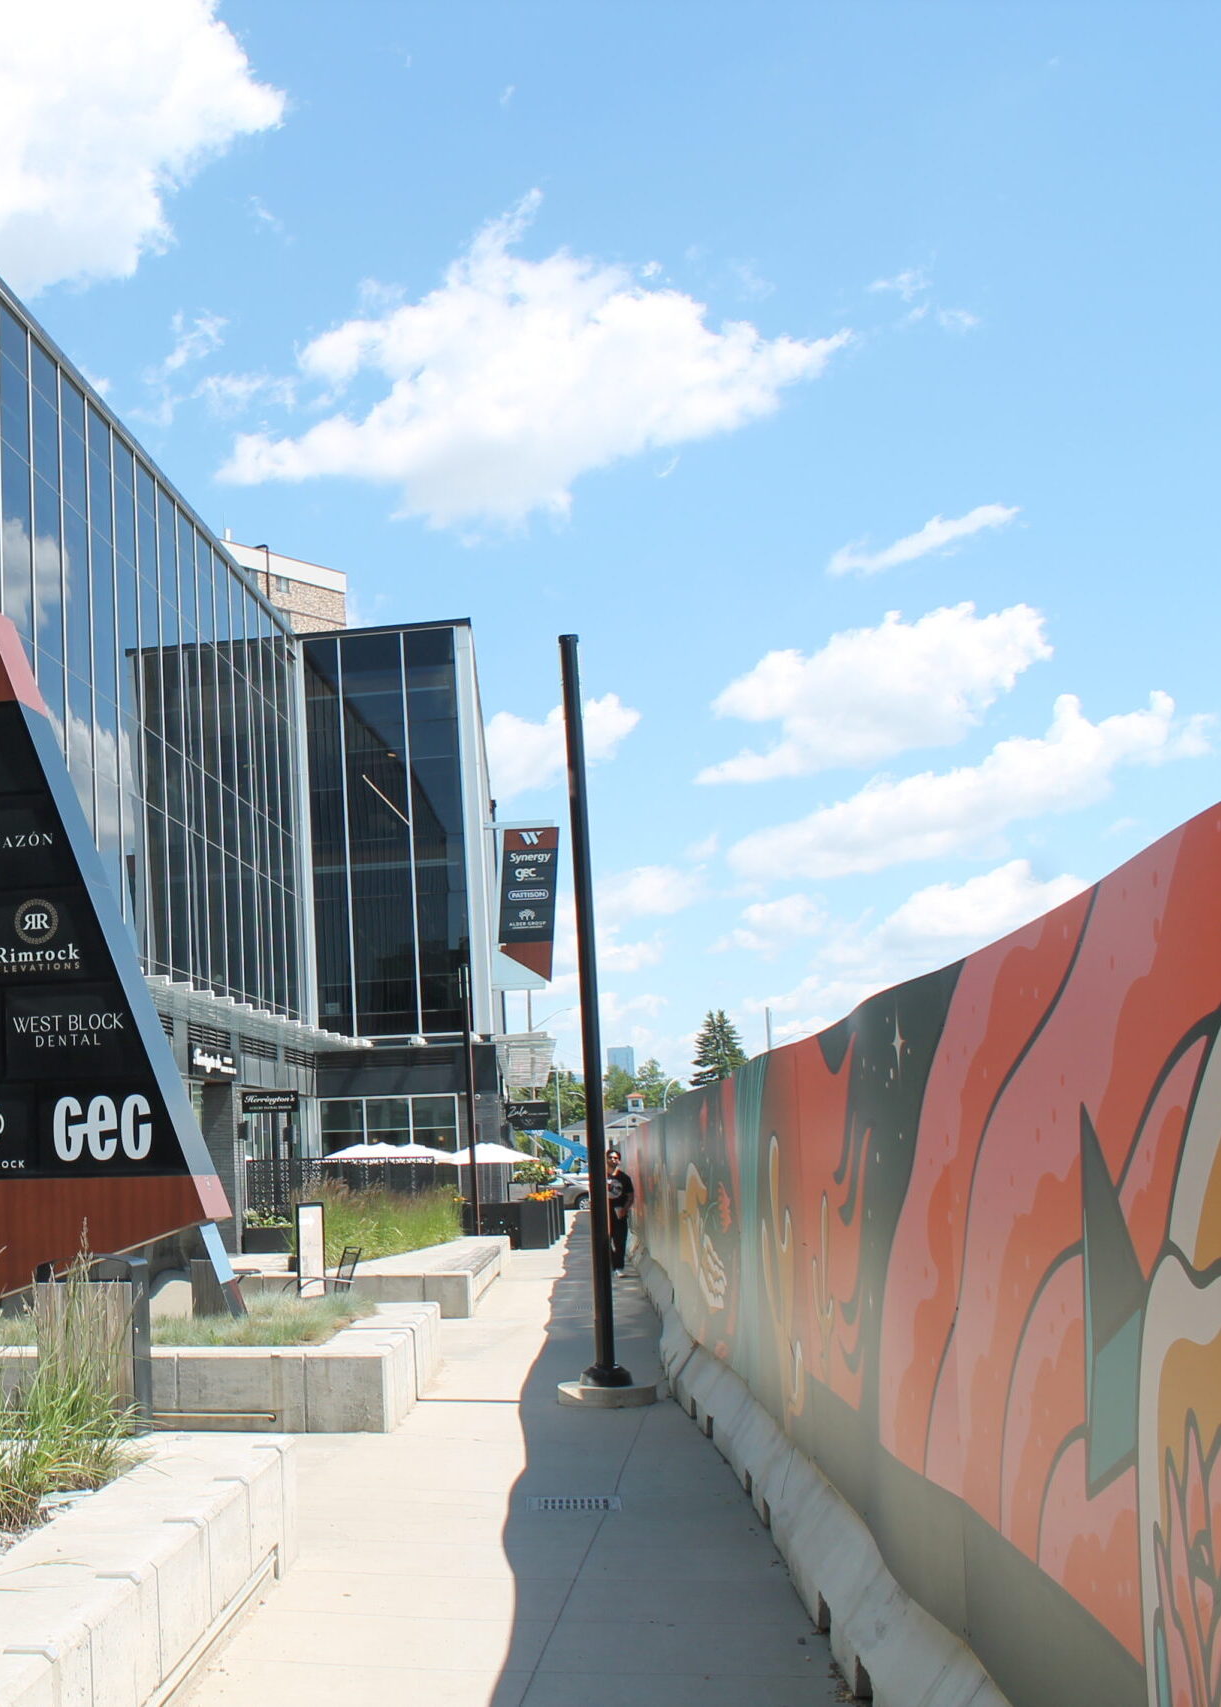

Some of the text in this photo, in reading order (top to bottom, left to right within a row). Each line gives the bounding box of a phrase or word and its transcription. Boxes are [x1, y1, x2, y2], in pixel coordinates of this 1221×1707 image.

[510, 853, 551, 864] Synergy
[511, 891, 546, 899] PATTISON
[12, 1012, 124, 1033] WEST BLOCK
[35, 1033, 102, 1048] DENTAL
